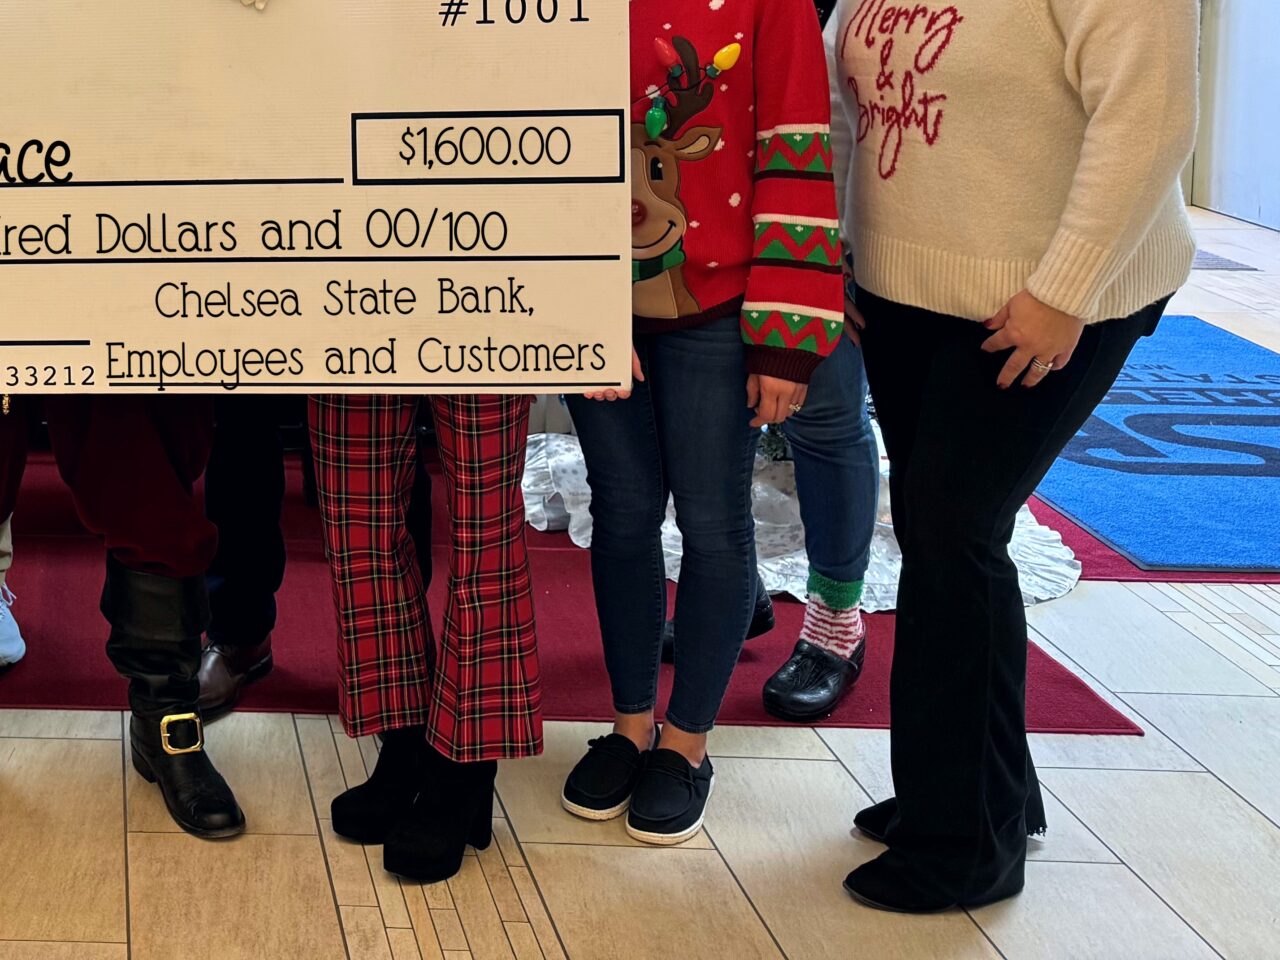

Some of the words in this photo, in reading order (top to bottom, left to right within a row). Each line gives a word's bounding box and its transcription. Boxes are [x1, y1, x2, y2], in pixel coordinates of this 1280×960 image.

[876, 39, 894, 91] &
[399, 126, 572, 170] $1,600.00
[95, 212, 238, 254] Dollars
[260, 208, 343, 251] and
[365, 207, 508, 252] 00/100
[154, 281, 303, 319] Chelsea
[323, 278, 417, 316] State
[437, 276, 534, 317] Bank,
[105, 341, 304, 390] Employees
[324, 337, 397, 375] and
[417, 336, 606, 374] Customers
